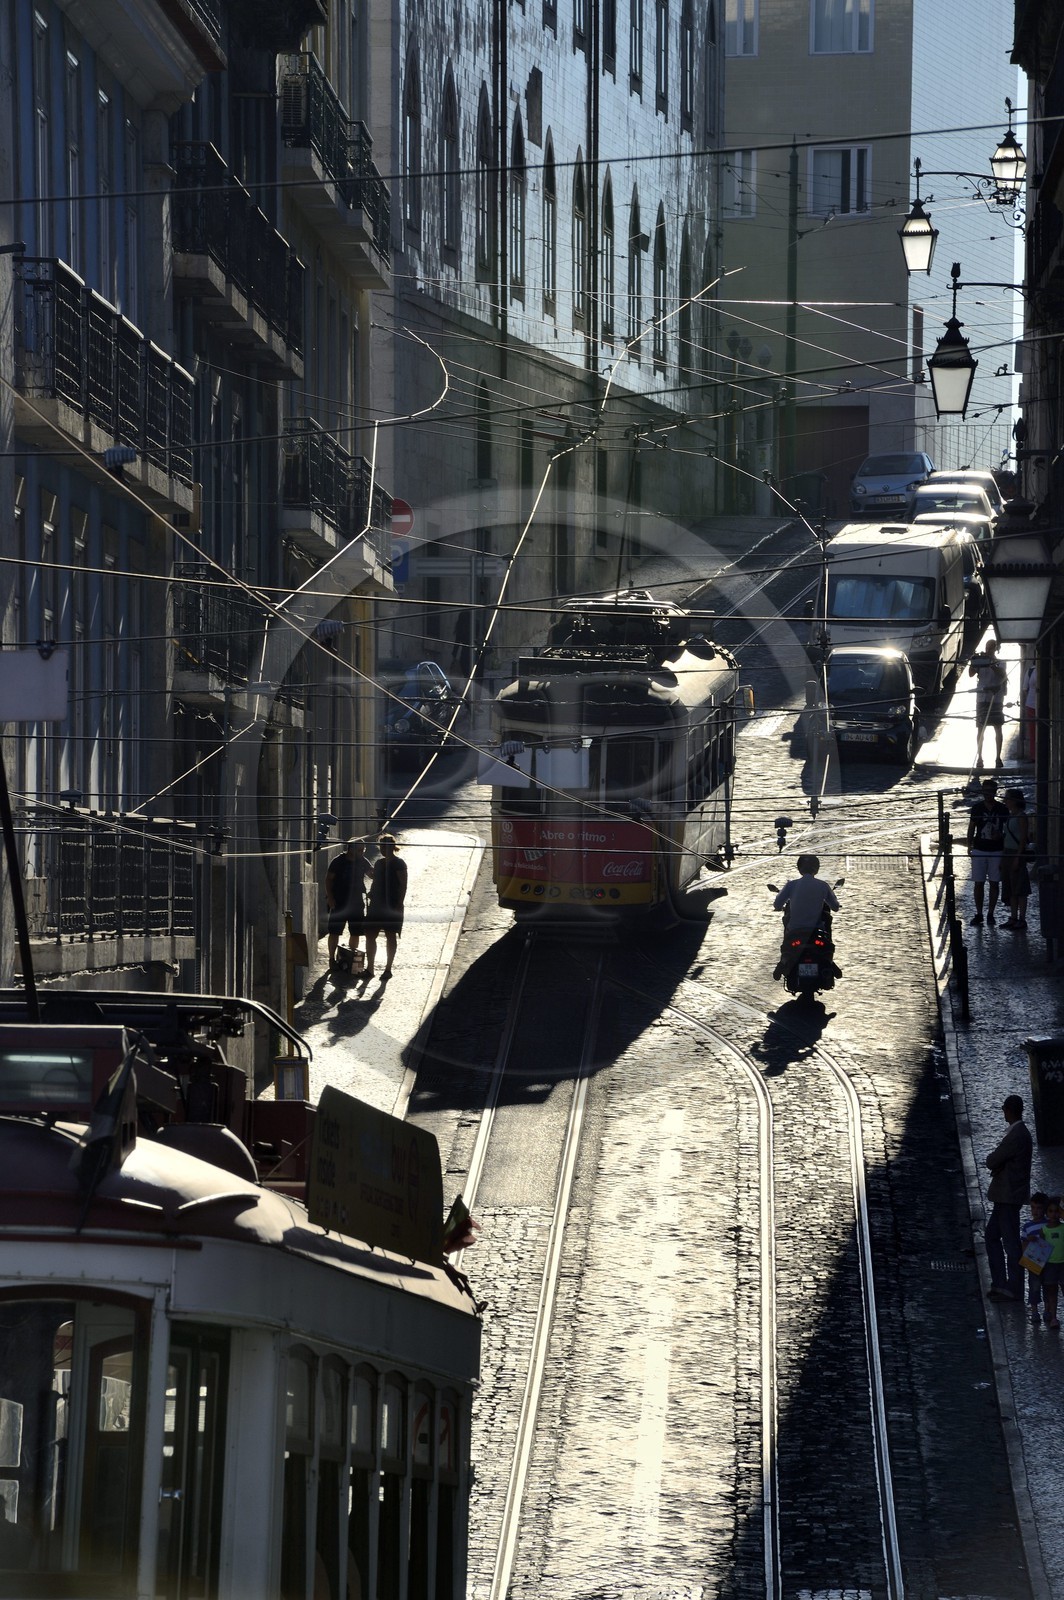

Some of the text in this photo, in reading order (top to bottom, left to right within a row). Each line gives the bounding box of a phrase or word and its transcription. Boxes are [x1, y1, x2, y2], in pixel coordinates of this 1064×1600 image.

[540, 830, 608, 843] Abre o ritmo
